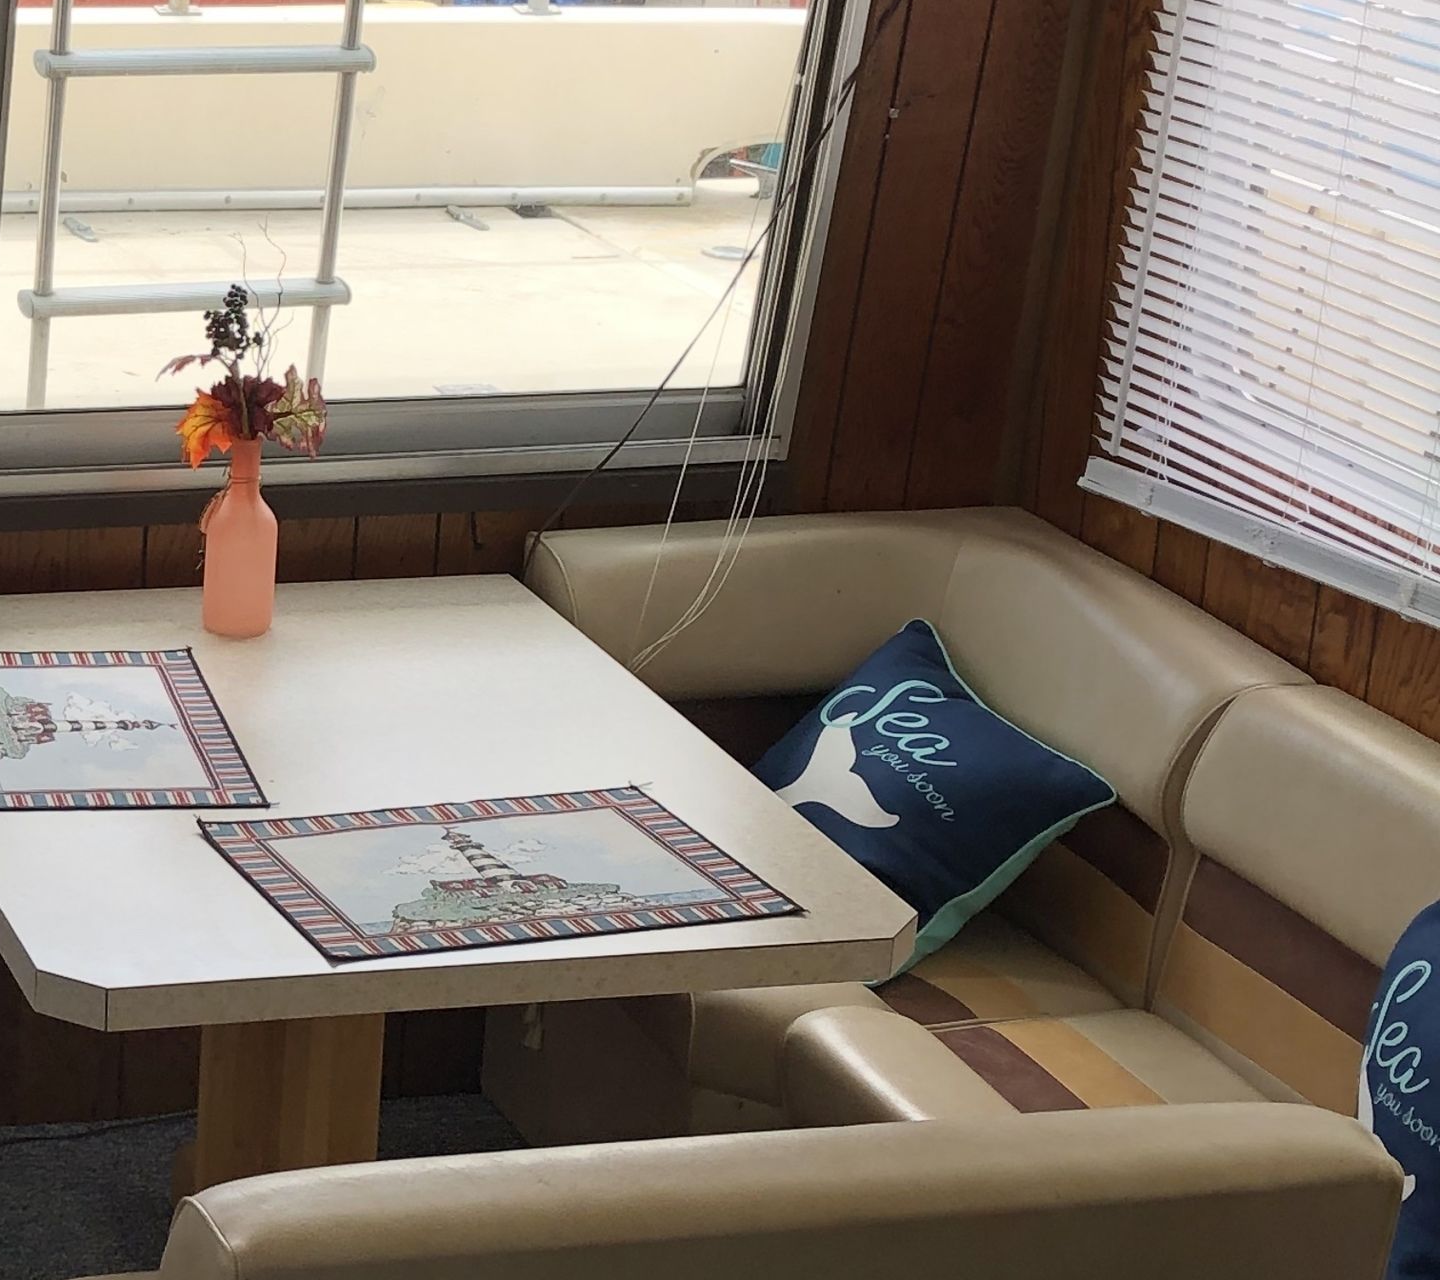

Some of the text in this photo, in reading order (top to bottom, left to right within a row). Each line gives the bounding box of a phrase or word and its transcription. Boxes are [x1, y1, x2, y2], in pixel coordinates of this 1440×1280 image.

[820, 679, 957, 766] Sea
[862, 743, 956, 822] you soon
[1373, 1082, 1403, 1117] you
